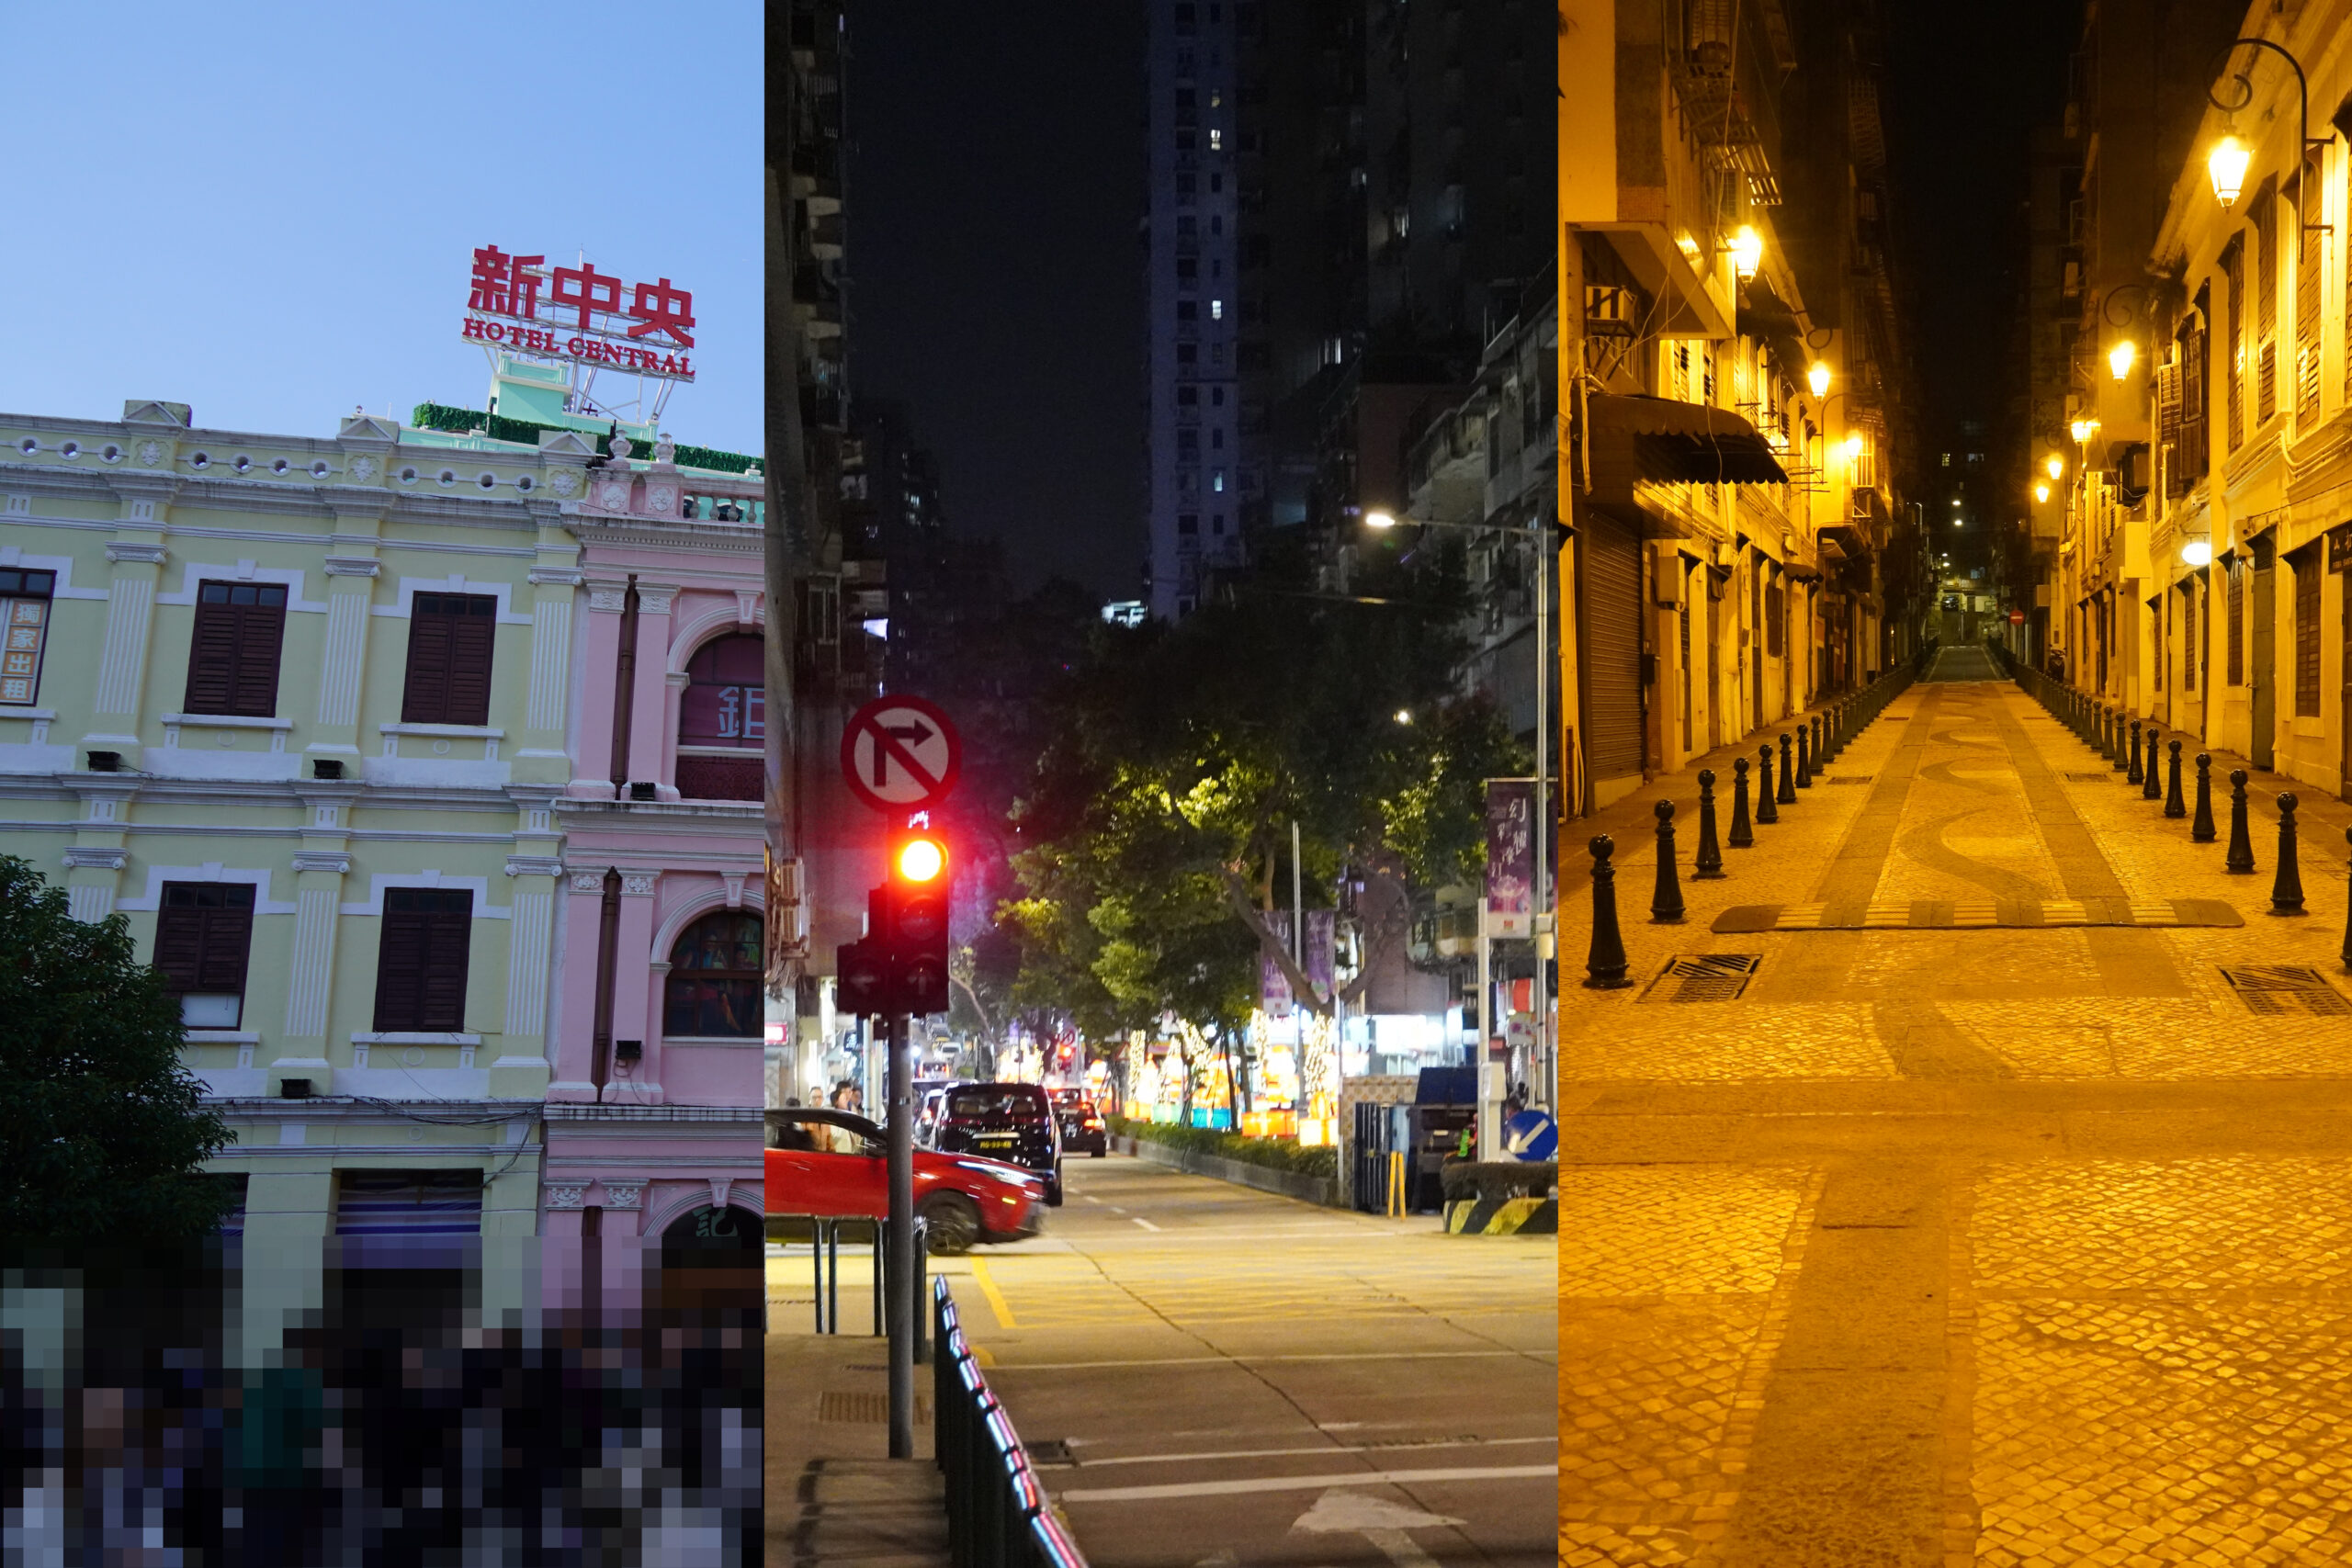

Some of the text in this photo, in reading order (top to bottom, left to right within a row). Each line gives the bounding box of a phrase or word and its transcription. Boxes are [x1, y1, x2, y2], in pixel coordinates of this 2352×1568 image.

[468, 244, 695, 349] 新中央
[462, 318, 695, 377] HOTEL CENTRAL
[3, 604, 40, 699] 獨家出租
